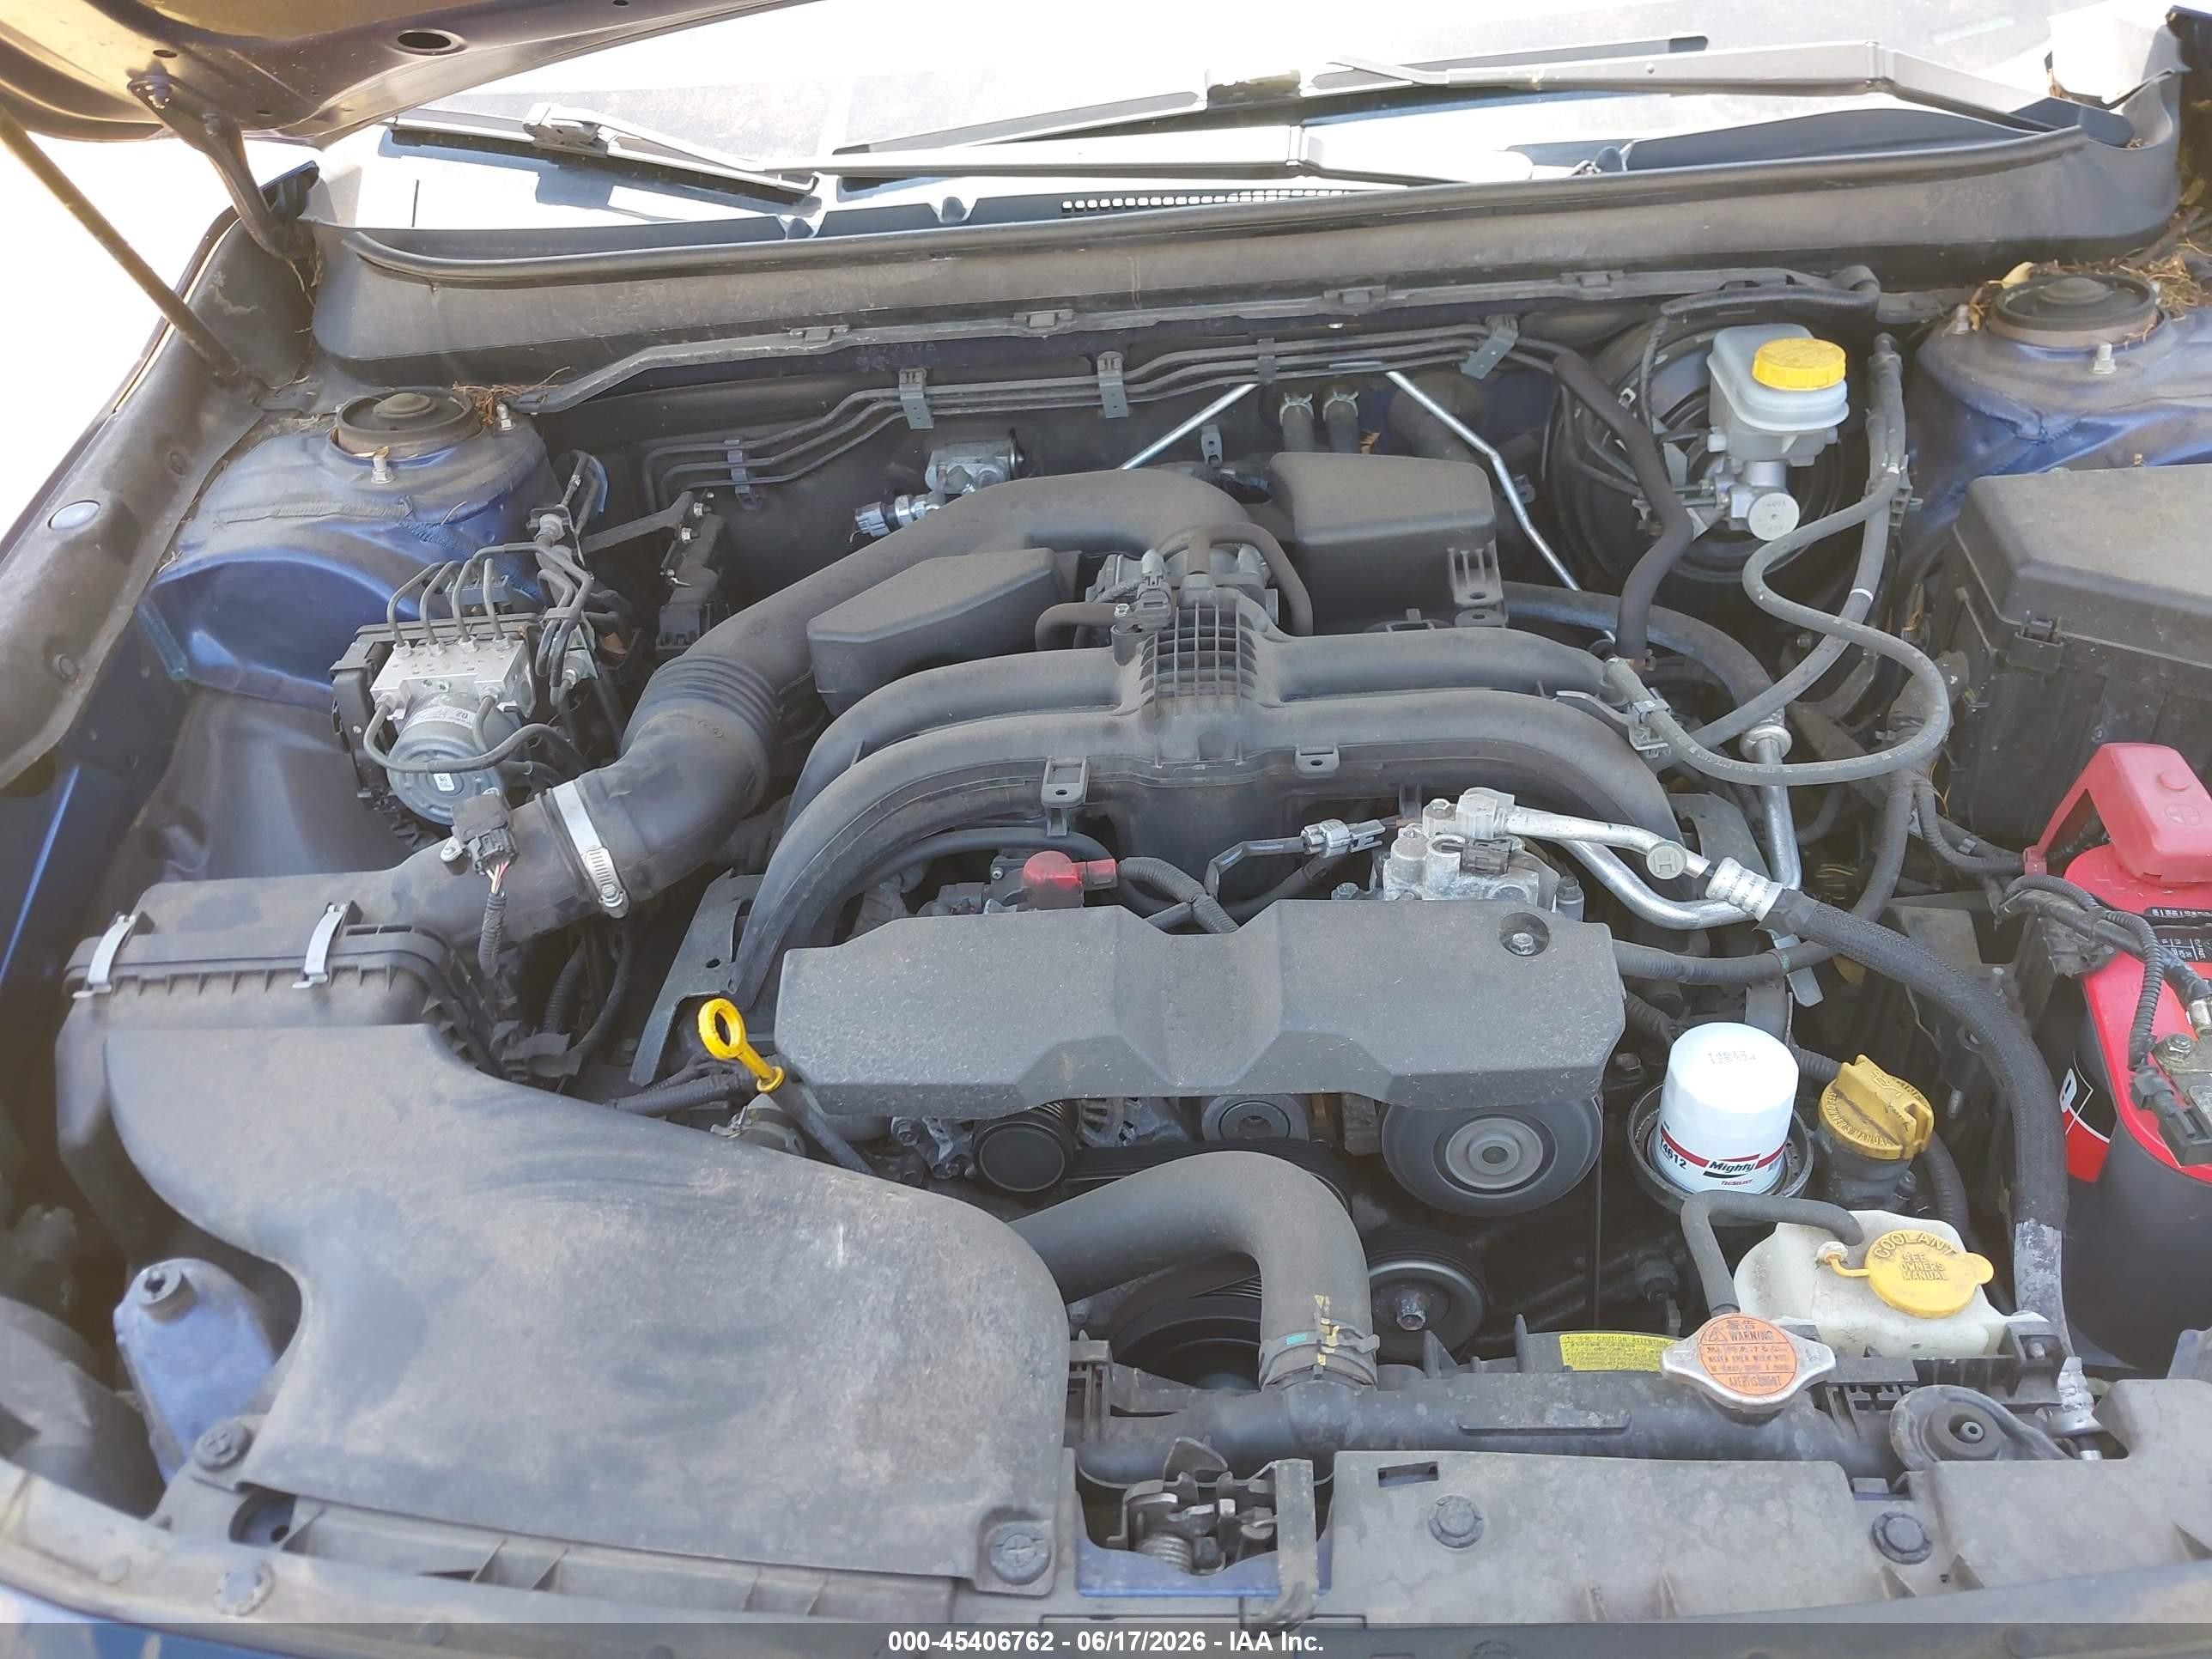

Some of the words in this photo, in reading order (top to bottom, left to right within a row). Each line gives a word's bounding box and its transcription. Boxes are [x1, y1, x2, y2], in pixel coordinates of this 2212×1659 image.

[1653, 851, 1676, 873] H
[1854, 1129, 1892, 1147] MANUAL
[1660, 1136, 1686, 1170] T4612
[1709, 1160, 1756, 1174] Mighty
[1875, 1231, 1958, 1259] COOLANT
[1902, 1252, 1927, 1261] SEE
[1899, 1261, 1944, 1271] OWNERS
[1902, 1271, 1948, 1281] MANUAL
[1730, 1330, 1773, 1341] WARNING
